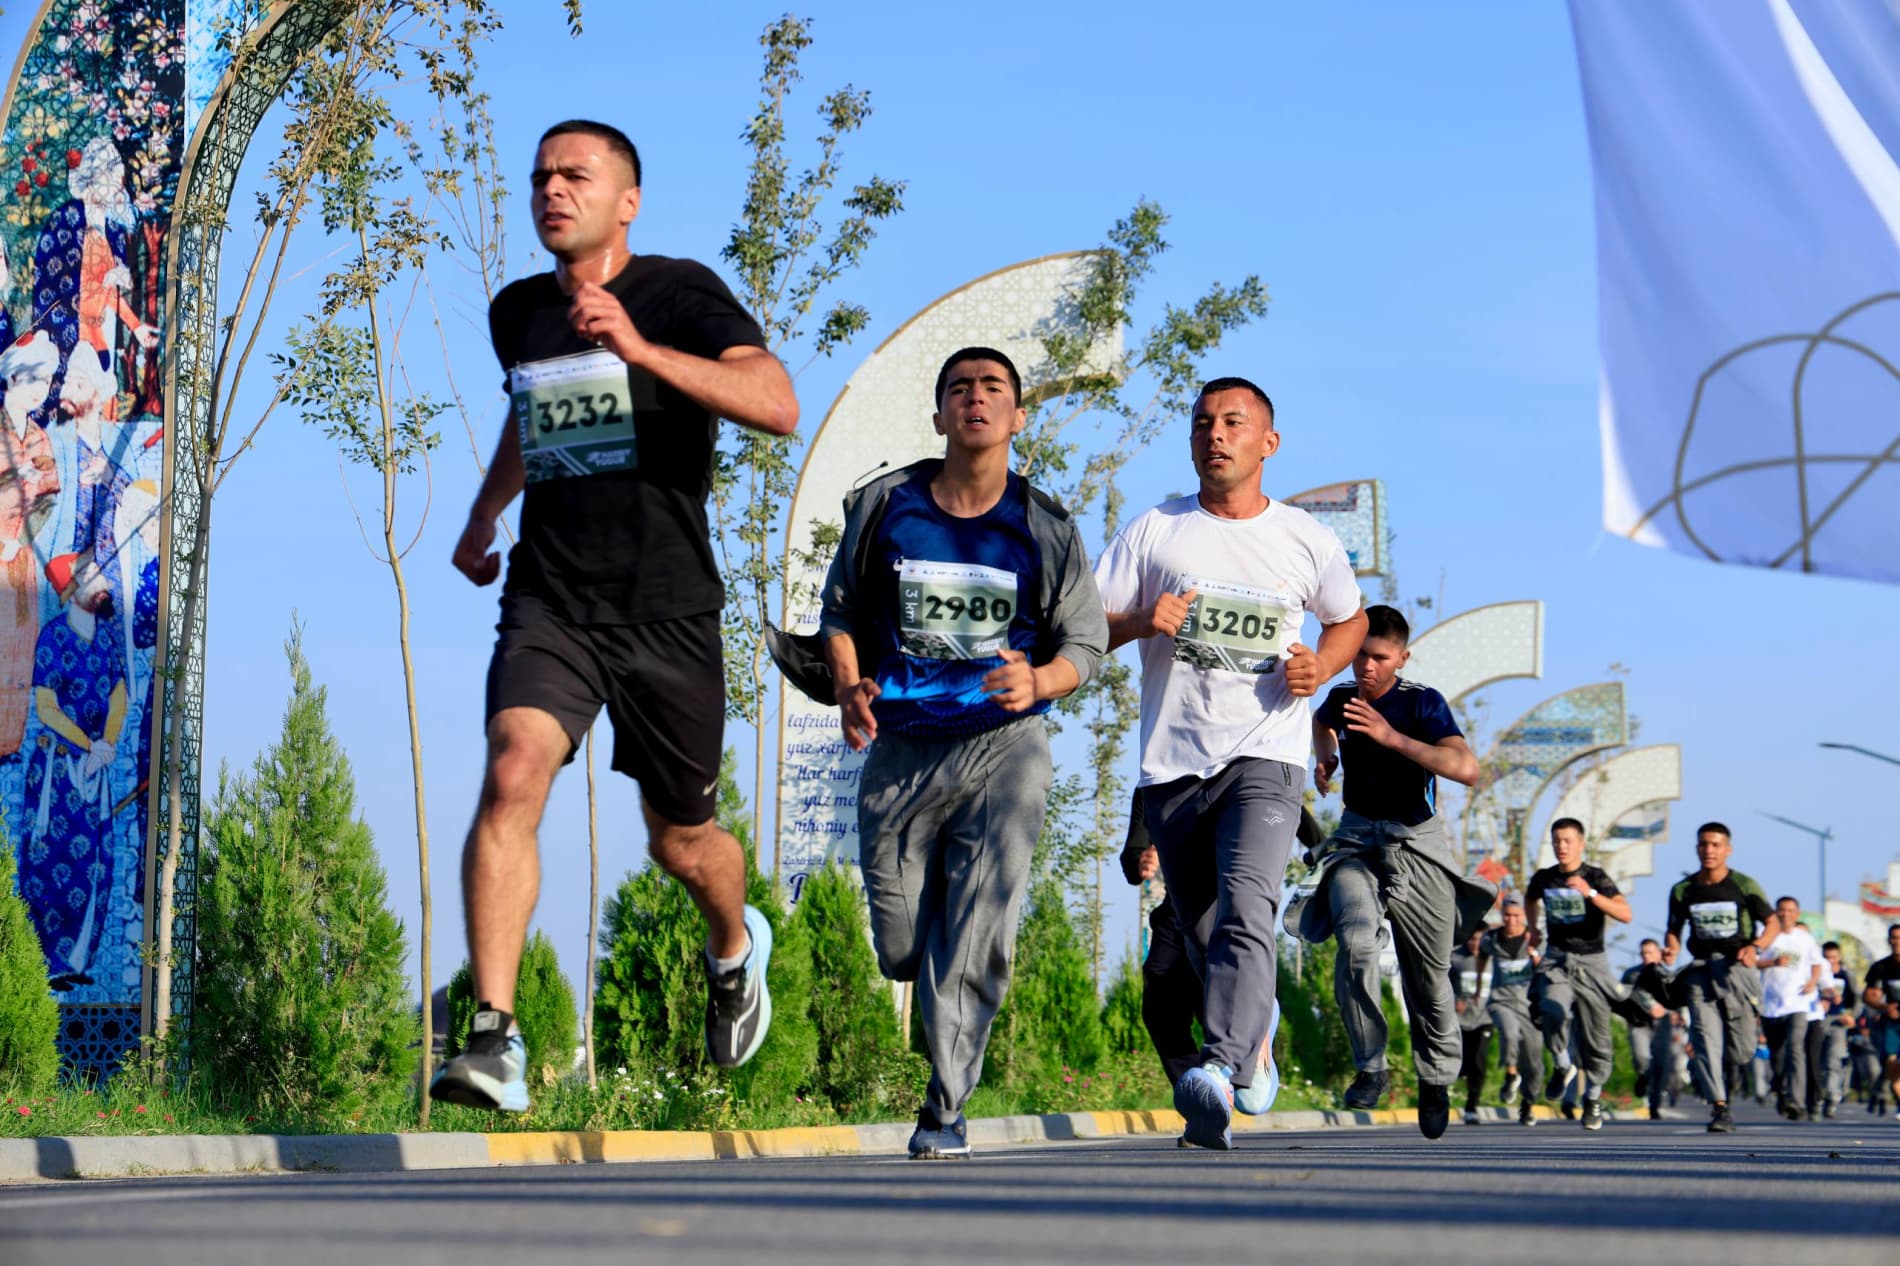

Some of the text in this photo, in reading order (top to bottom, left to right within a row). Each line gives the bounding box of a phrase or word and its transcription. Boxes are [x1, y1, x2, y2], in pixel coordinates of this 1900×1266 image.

[518, 402, 529, 444] 3 km
[536, 392, 623, 434] 3232
[905, 588, 919, 624] 3 km
[925, 595, 1011, 622] 2980
[1182, 601, 1198, 632] 3 km
[1202, 607, 1278, 640] 3205
[787, 713, 840, 735] lafzida
[785, 743, 813, 760] yuz
